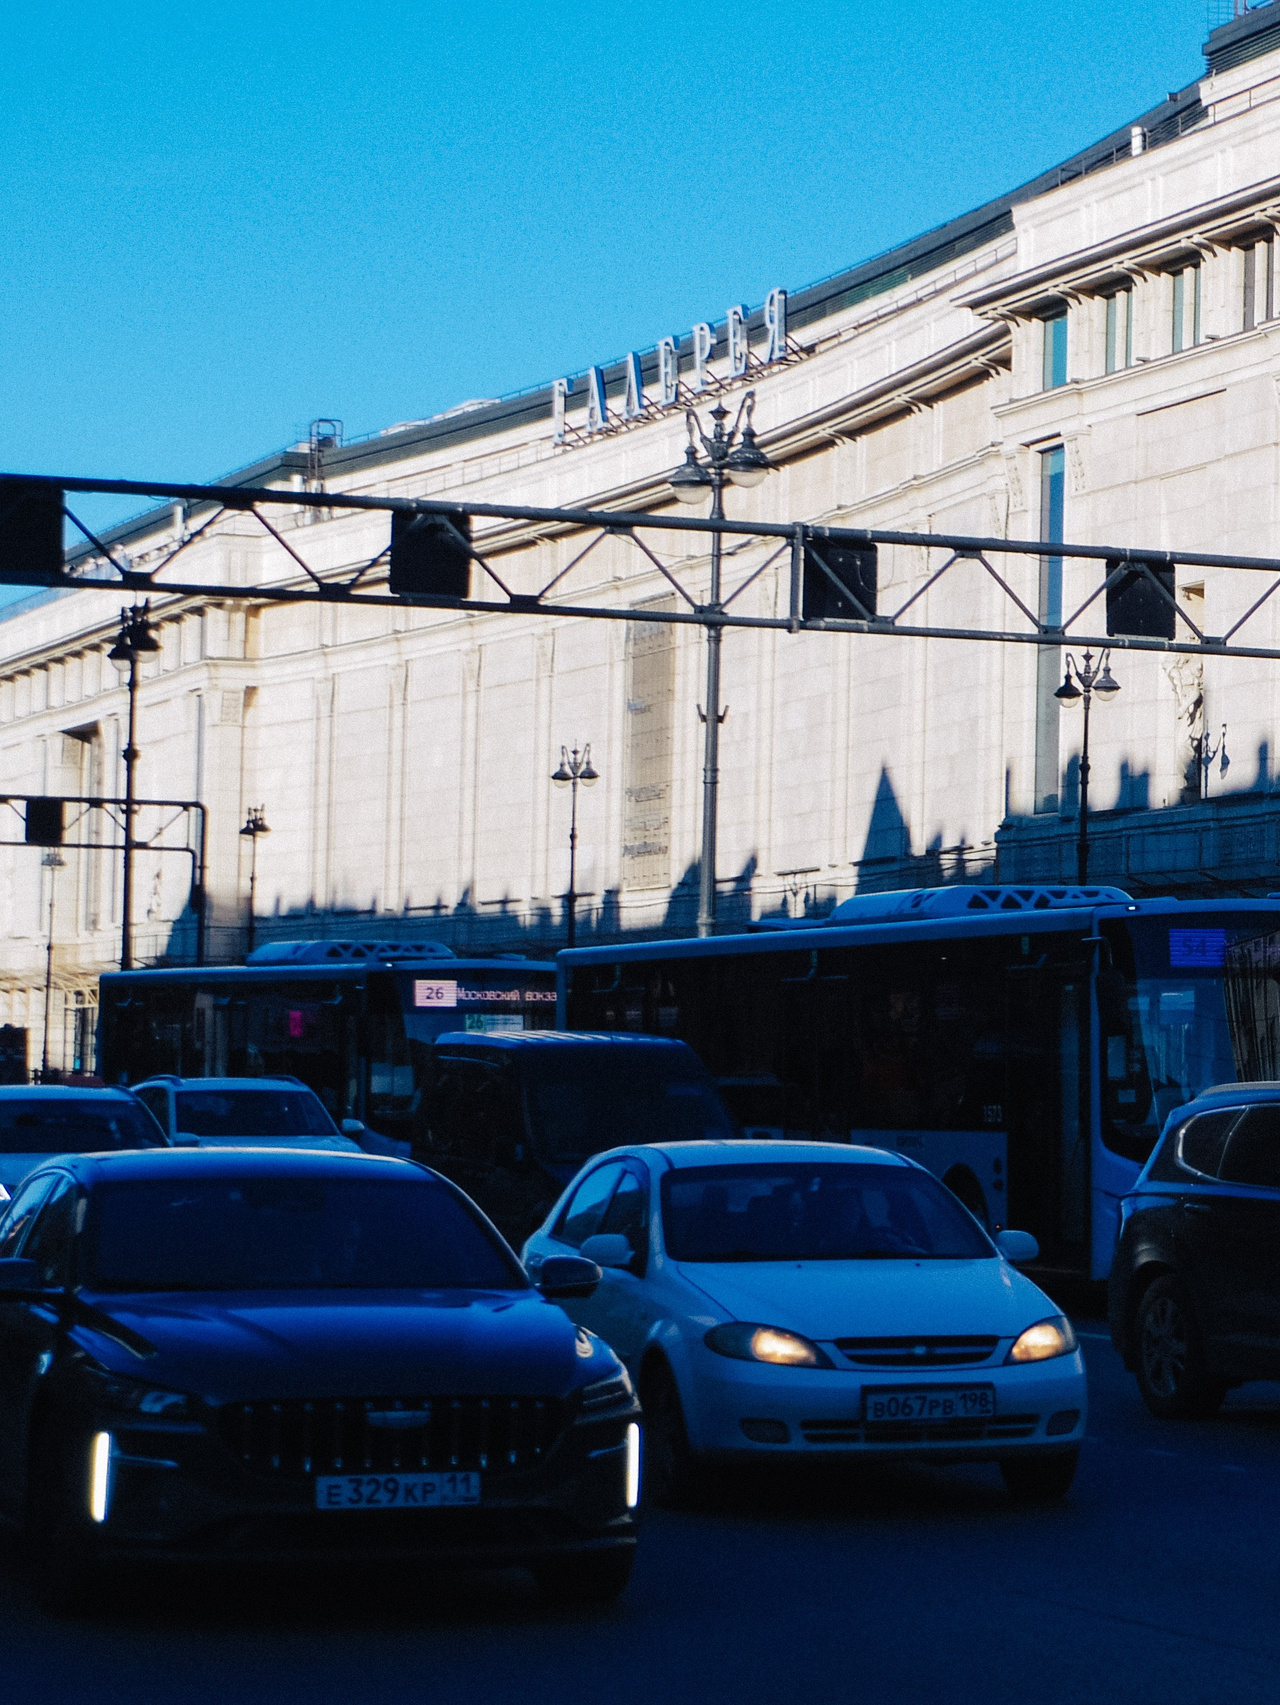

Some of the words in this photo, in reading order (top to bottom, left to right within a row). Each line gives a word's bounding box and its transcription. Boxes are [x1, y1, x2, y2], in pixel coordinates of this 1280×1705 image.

[552, 287, 788, 445] ГАЛЕРЕЯ
[425, 987, 444, 1000] 26
[457, 987, 520, 1001] Московский
[467, 1014, 484, 1030] 26
